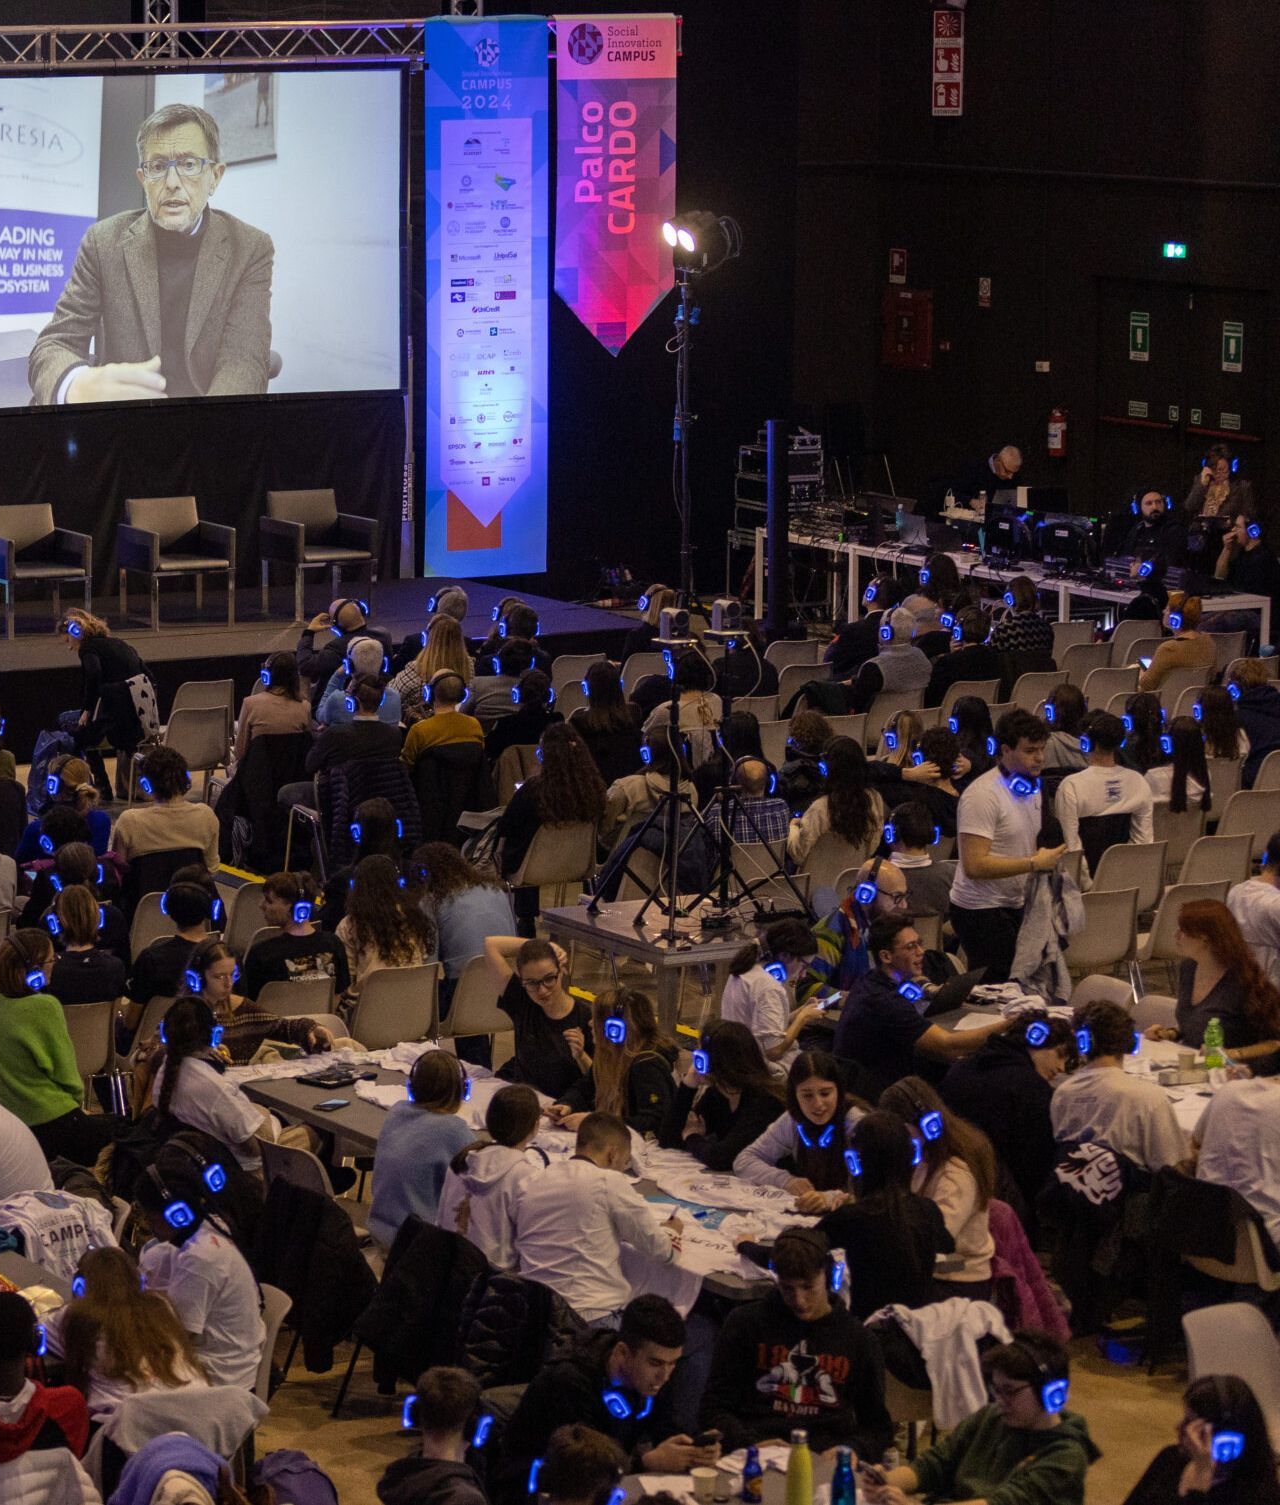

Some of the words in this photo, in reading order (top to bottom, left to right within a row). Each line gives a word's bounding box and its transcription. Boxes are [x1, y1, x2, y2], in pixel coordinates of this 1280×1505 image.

[607, 25, 639, 37] Social
[607, 37, 663, 49] Innovation
[607, 50, 657, 62] CAMPUS
[462, 79, 513, 91] CAMPUS
[462, 95, 513, 111] 2024
[575, 101, 604, 203] Palco
[608, 101, 638, 235] CARDO
[23, 248, 36, 261] IN
[38, 248, 63, 262] NEW
[12, 263, 64, 277] BUSINESS
